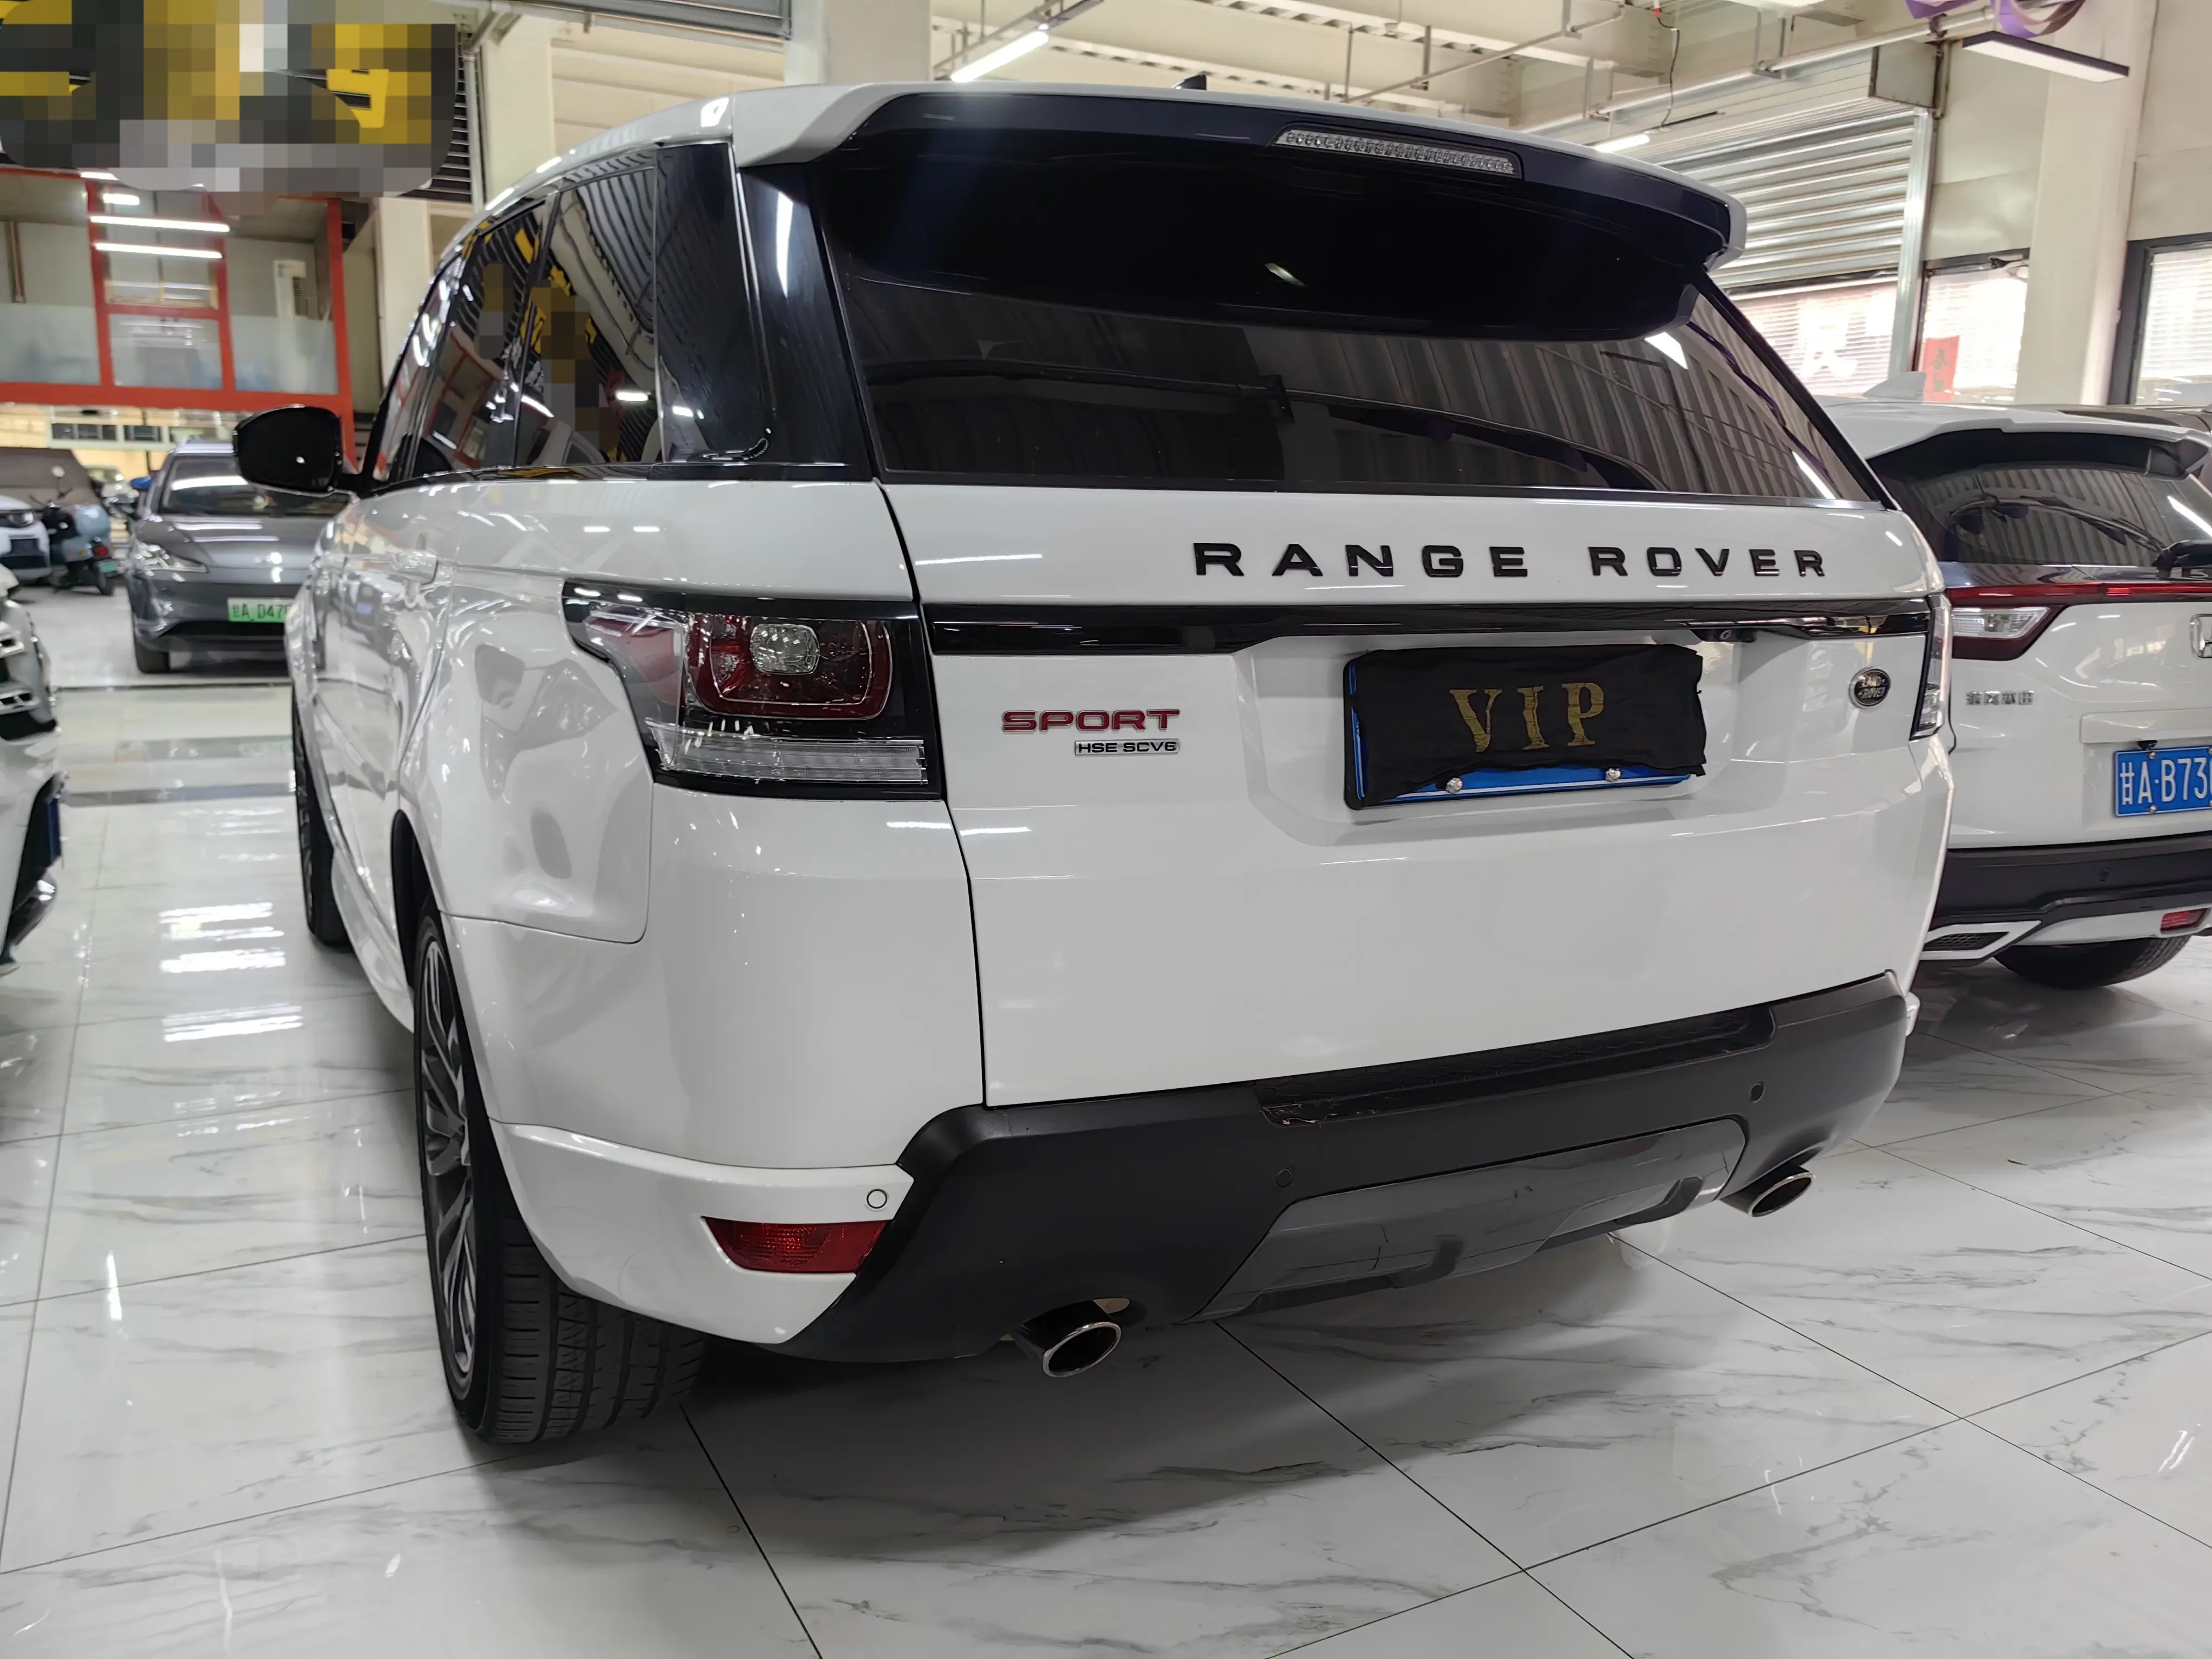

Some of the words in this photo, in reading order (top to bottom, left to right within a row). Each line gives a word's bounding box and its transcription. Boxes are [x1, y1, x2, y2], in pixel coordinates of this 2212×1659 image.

[1193, 542, 1528, 577] RANGE
[1588, 541, 1825, 576] ROVER
[1860, 686, 1886, 699] ROVER
[1002, 709, 1180, 731] SPORT
[1449, 682, 1604, 753] VIP
[1078, 743, 1118, 753] HSE
[1123, 741, 1177, 752] SCV6
[2120, 757, 2212, 806] 甘A·B73
